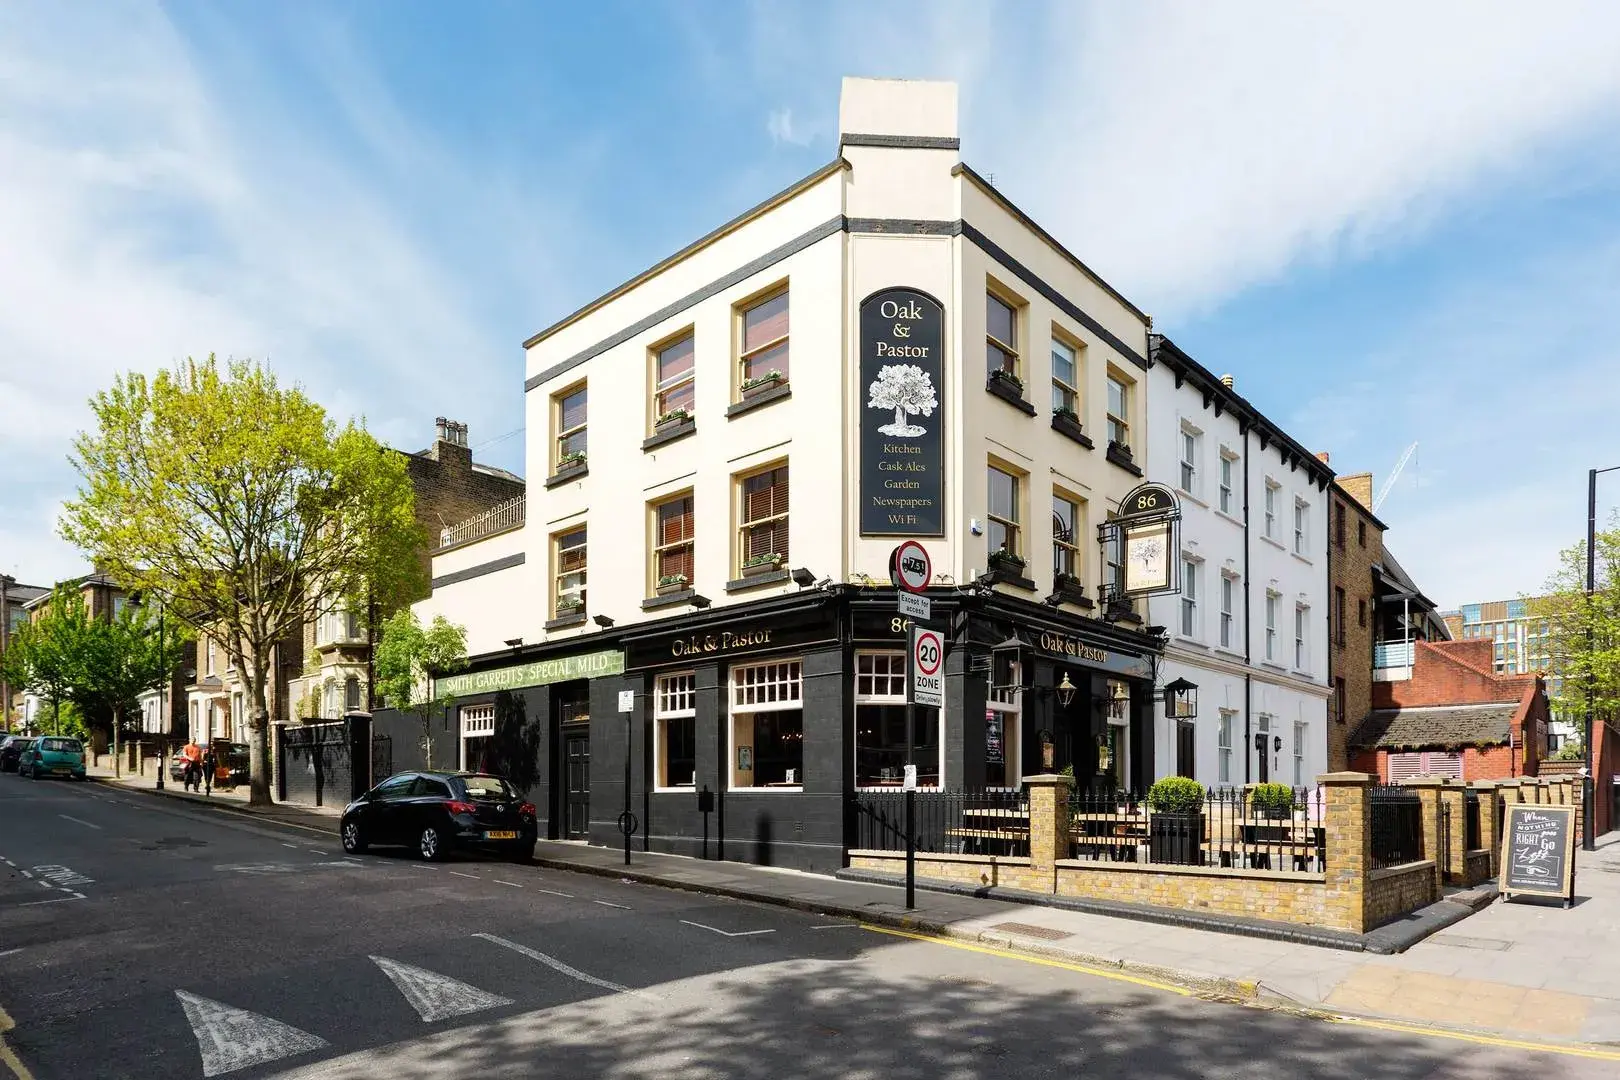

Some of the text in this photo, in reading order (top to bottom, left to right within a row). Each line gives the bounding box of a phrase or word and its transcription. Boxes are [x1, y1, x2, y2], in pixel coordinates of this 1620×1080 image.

[880, 300, 922, 320] Oak
[893, 323, 911, 338] &
[876, 341, 929, 358] Pastor
[883, 443, 921, 454] Kitchen
[878, 460, 927, 472] Cask Ales
[884, 479, 920, 489] Garden
[872, 496, 932, 508] Newspapers
[1138, 493, 1156, 509] 86
[901, 594, 929, 608] Except for
[906, 605, 925, 615] access
[672, 629, 772, 657] Oak & Pastor
[1041, 633, 1108, 663] Oak & Pastor
[920, 645, 938, 663] 20
[446, 678, 473, 693] SMITH
[529, 659, 571, 680] SPECIAL
[577, 654, 608, 673] MILD
[917, 676, 939, 689] ZONE
[1522, 811, 1549, 822] When
[1517, 822, 1557, 831] NOTHING
[1515, 832, 1539, 846] RIGHT
[1540, 838, 1556, 852] Go
